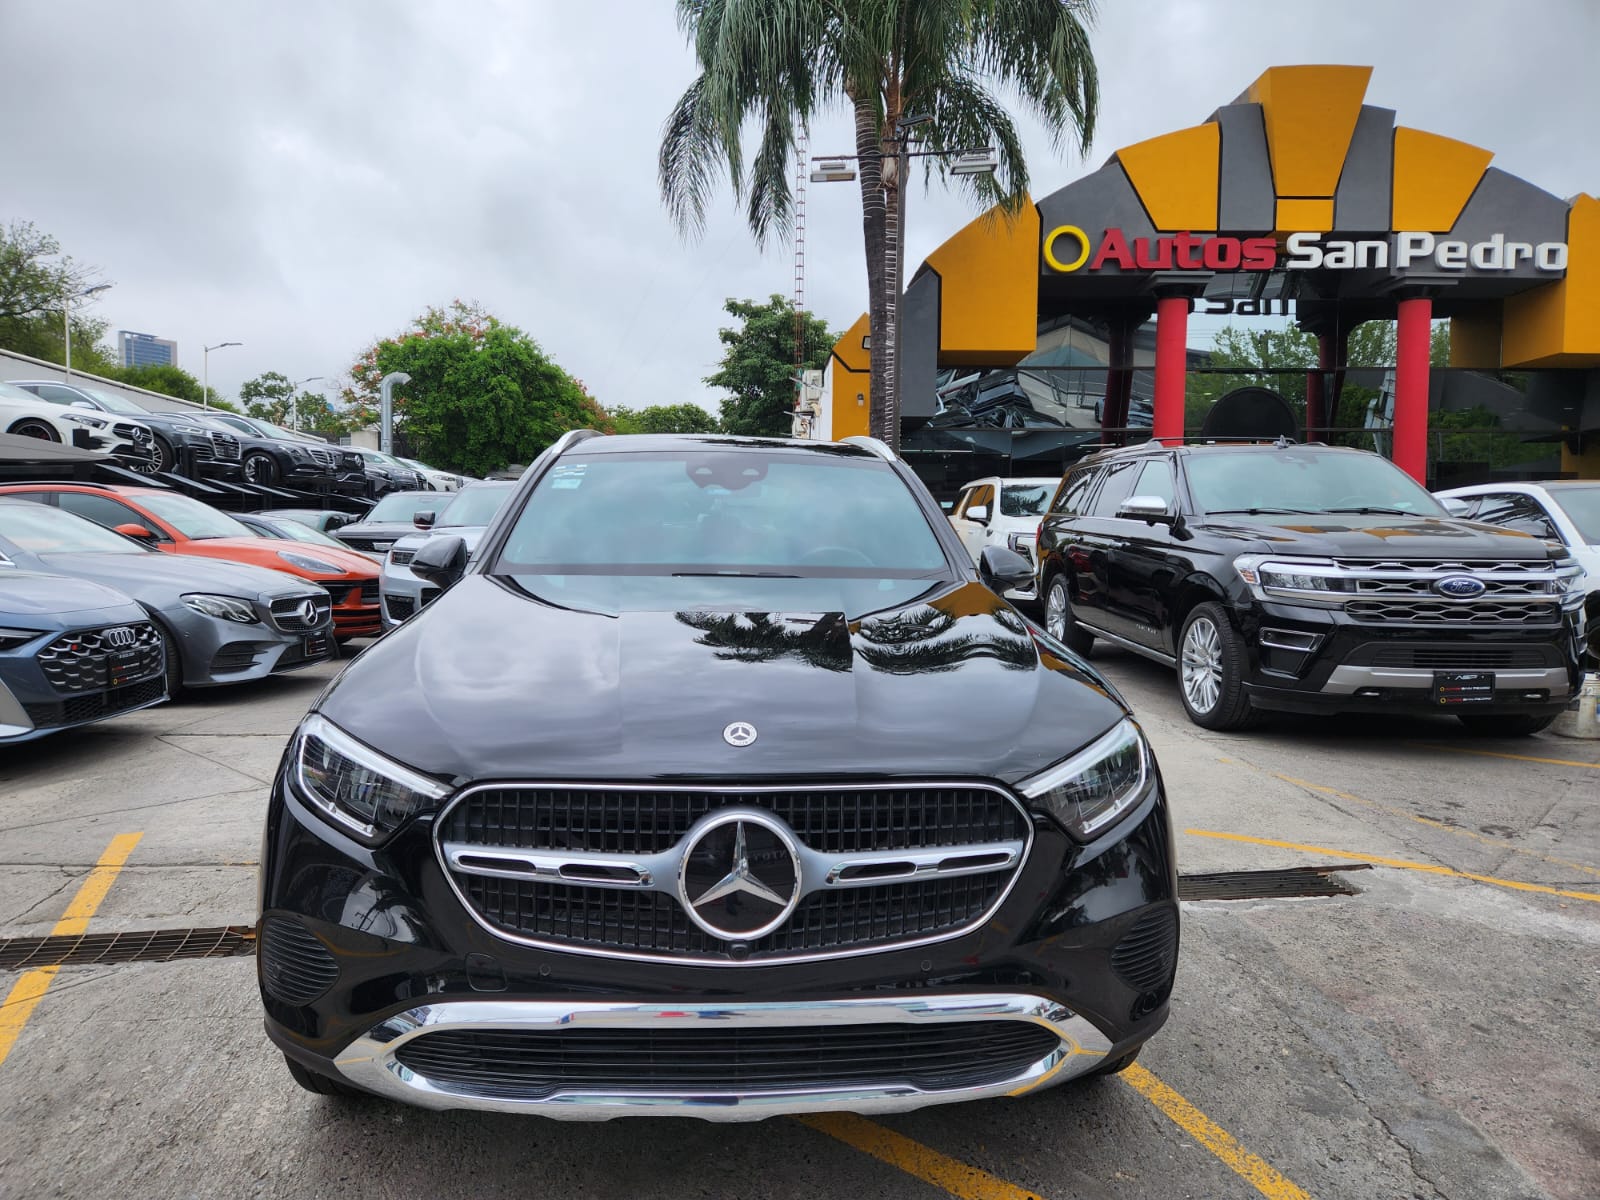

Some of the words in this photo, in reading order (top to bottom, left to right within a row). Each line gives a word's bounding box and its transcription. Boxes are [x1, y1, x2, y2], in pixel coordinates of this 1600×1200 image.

[1088, 228, 1276, 270] Autos
[1286, 232, 1388, 269] San
[1397, 232, 1568, 270] Pedro
